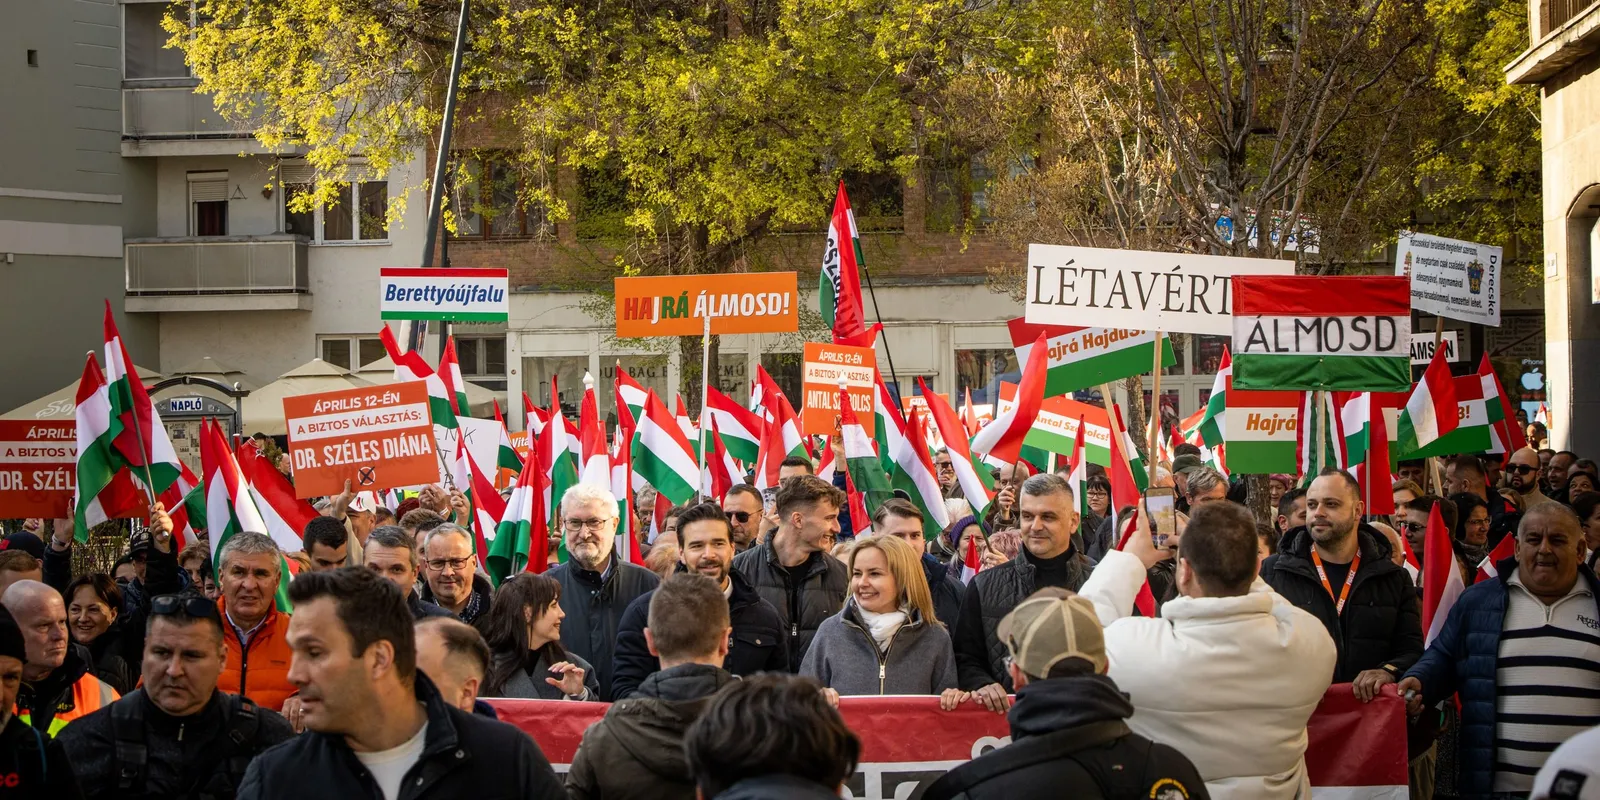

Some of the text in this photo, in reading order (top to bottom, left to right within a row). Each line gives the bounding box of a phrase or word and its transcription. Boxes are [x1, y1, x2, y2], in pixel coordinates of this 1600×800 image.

[385, 284, 504, 306] Berettyóújfalu
[1031, 259, 1232, 315] LÉTAVÉRT
[1488, 255, 1498, 315] Derecske
[624, 290, 790, 324] HAJRÁ ÁLMOSD!
[1244, 314, 1398, 353] ÁLMOSD
[818, 349, 863, 364] ÁPRILIS 12-ÉN
[1047, 334, 1079, 362] ajrá
[1410, 338, 1454, 360] ÁMSN
[629, 367, 655, 378] BAG
[809, 368, 871, 382] A BIZTOS VASZTÁS:
[171, 398, 202, 411] NAPLÓ
[313, 391, 401, 413] ÁPRILIS 12-ÉN
[807, 390, 871, 412] ANTAL SZOLCS
[297, 410, 422, 434] A BIZTOS VÁLASZTÁS:
[1036, 414, 1109, 441] Antal Szolcs!
[1246, 413, 1297, 435] Hajrá
[5, 448, 15, 457] A
[18, 448, 66, 457] BIZTOS
[296, 448, 322, 470] DR.
[323, 438, 379, 465] SZÉLES
[382, 432, 431, 459] DIÁNA
[0, 467, 76, 491] DR. SZÉL
